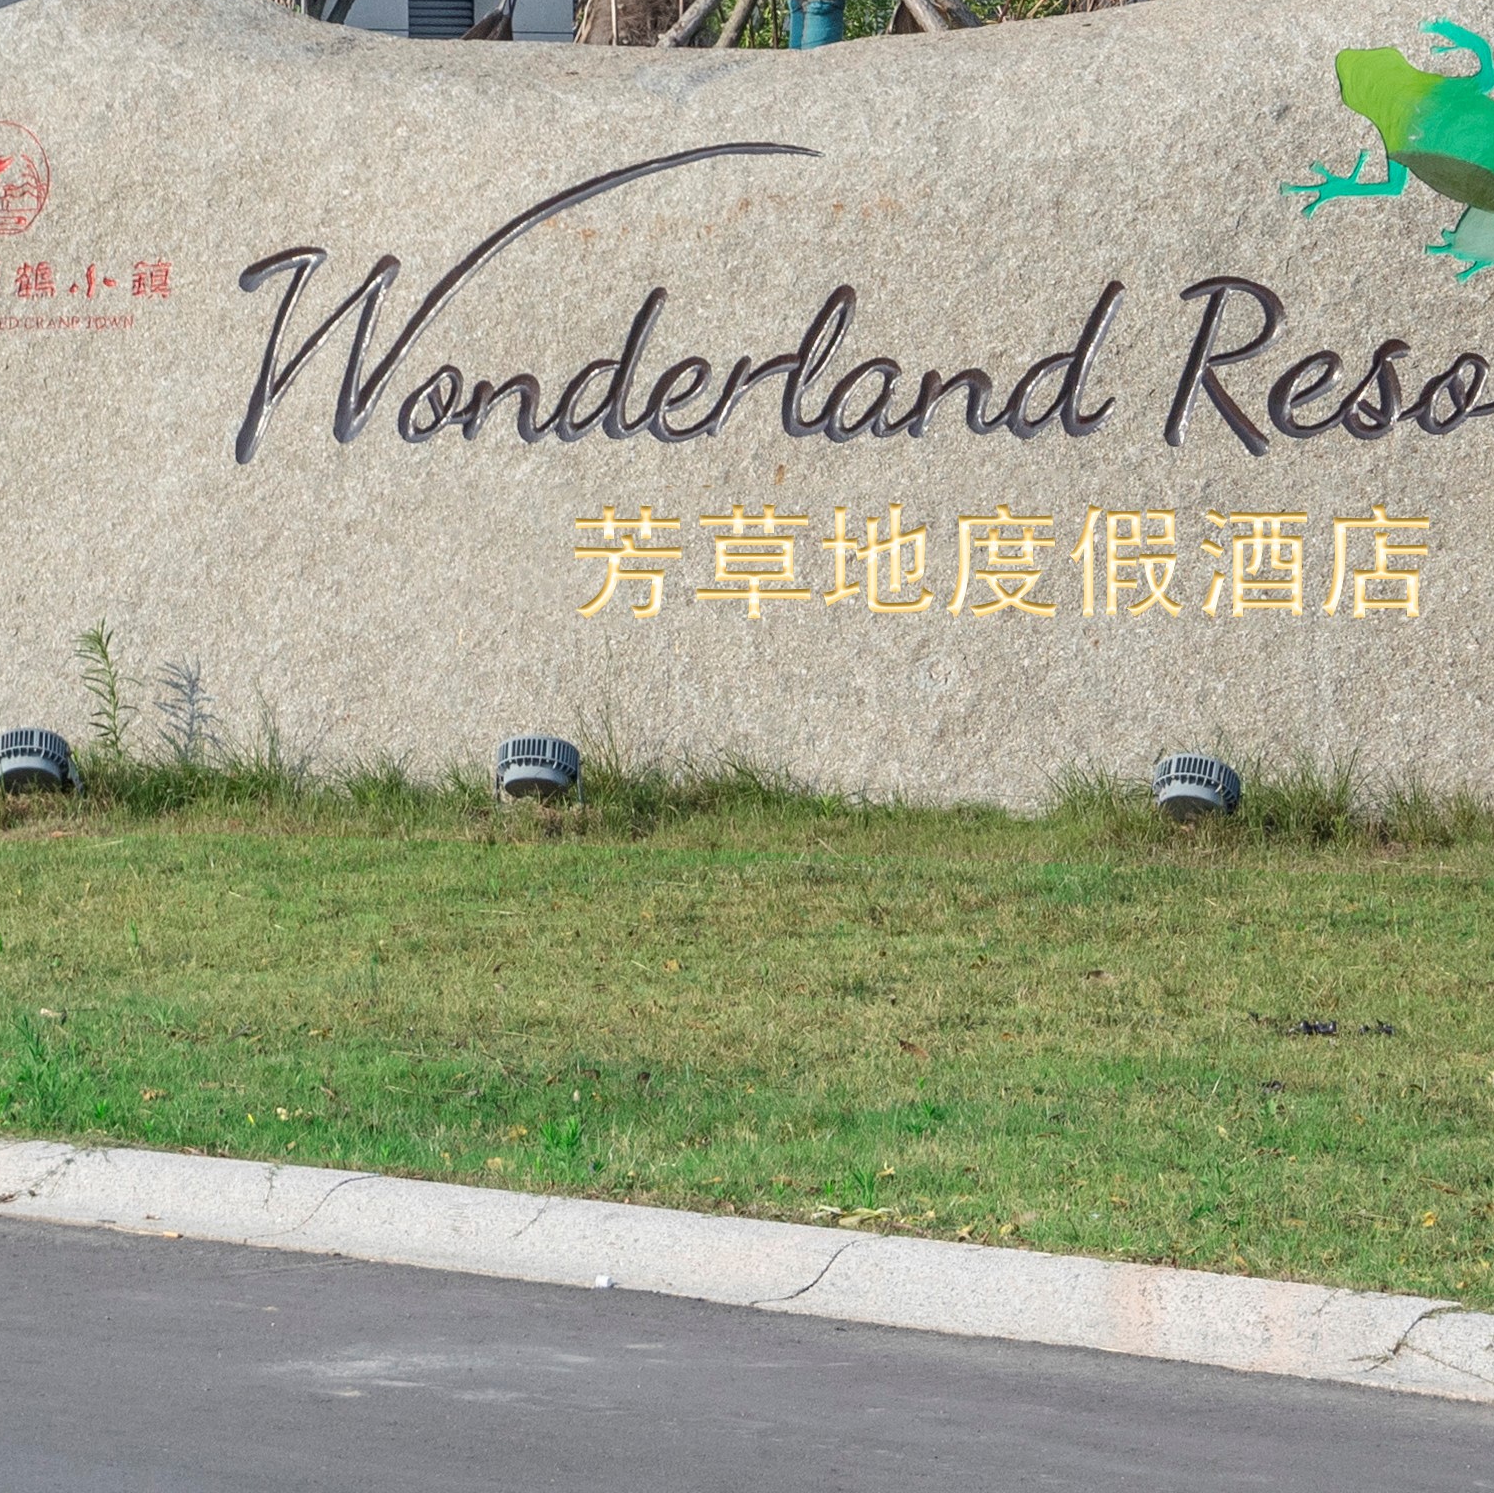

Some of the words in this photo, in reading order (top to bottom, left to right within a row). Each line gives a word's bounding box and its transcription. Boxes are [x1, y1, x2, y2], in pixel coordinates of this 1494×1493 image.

[84, 314, 135, 330] TOWN
[236, 142, 1126, 465] Wonderland
[573, 503, 1431, 618] 芳草地度假酒店
